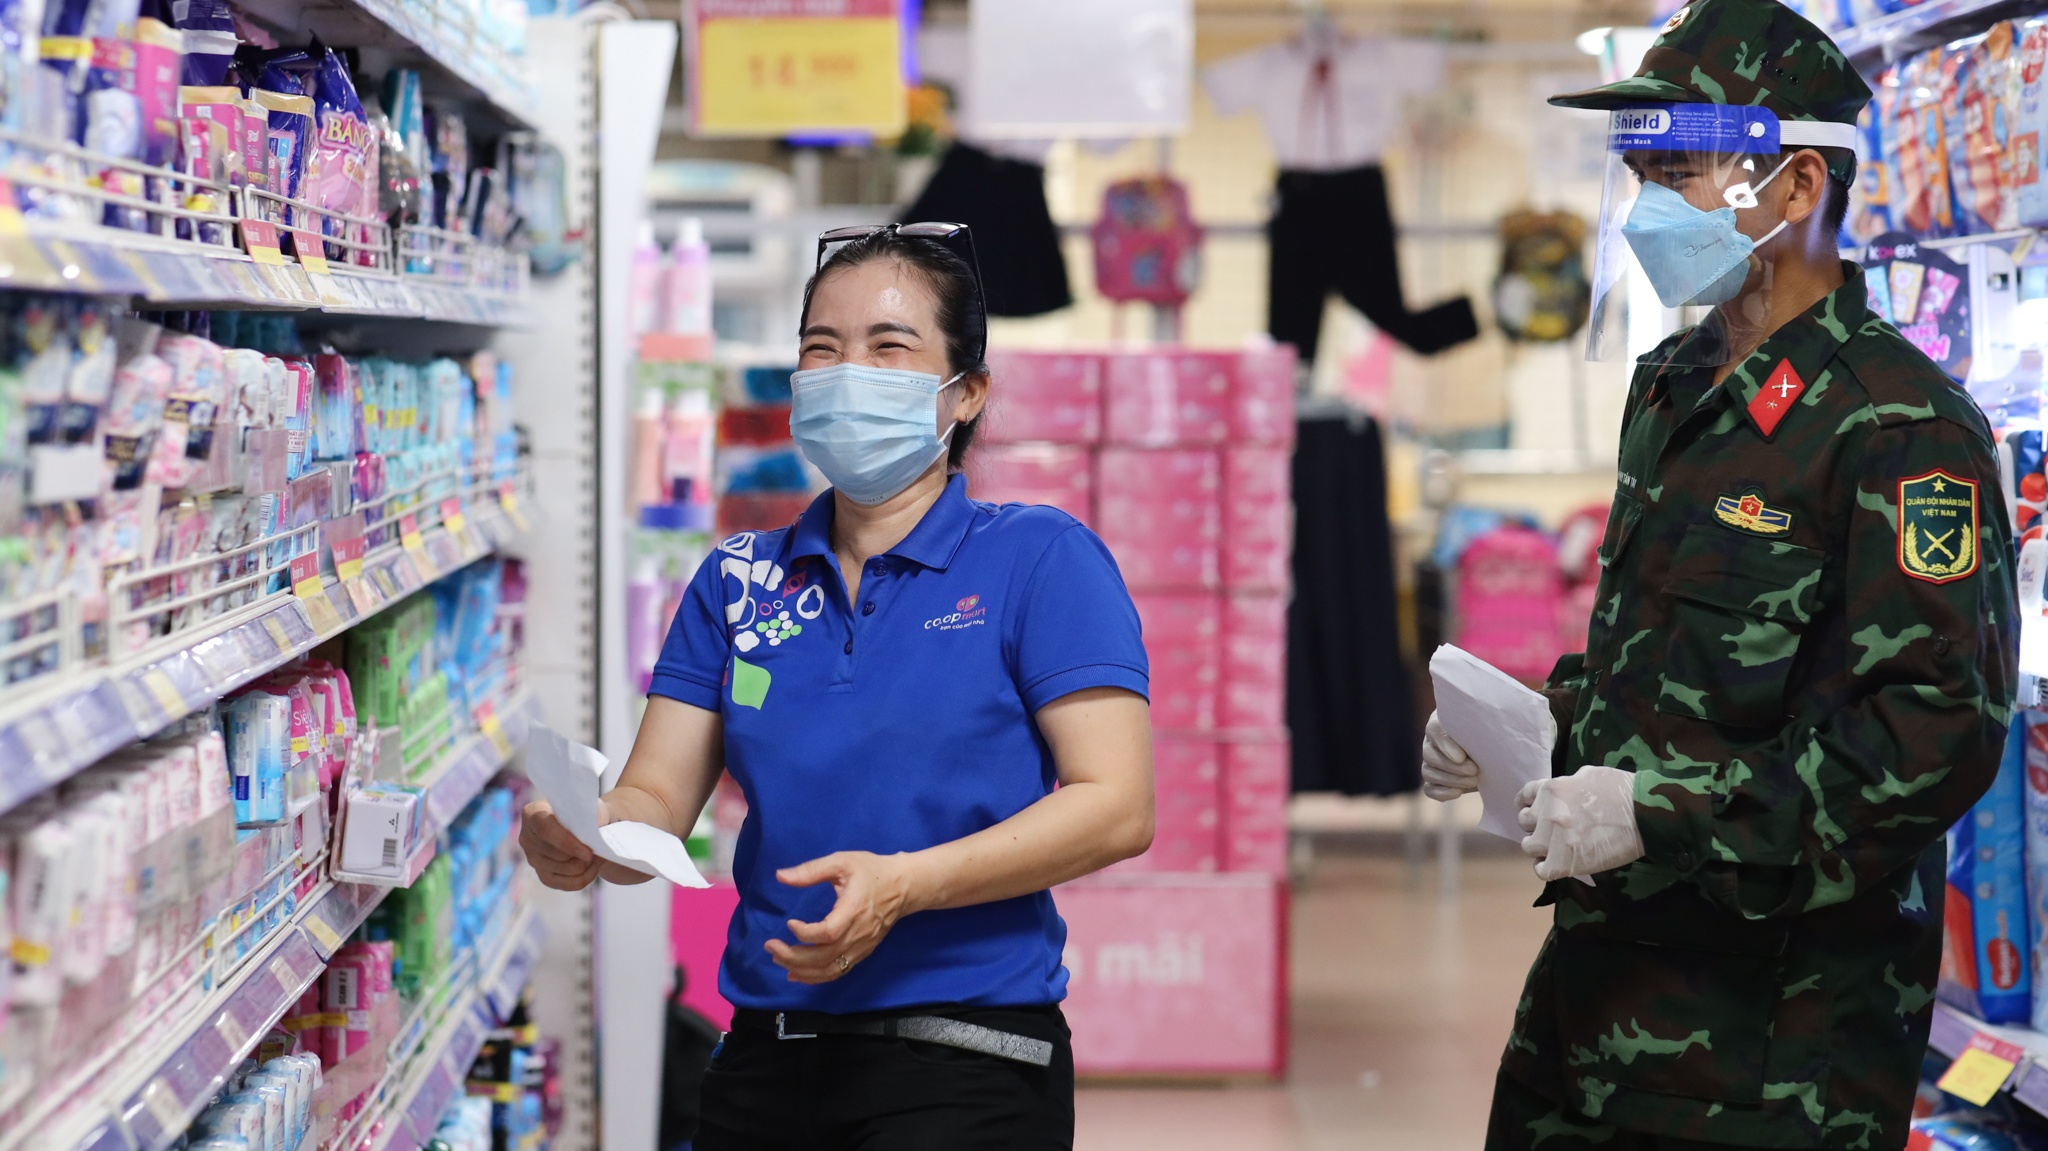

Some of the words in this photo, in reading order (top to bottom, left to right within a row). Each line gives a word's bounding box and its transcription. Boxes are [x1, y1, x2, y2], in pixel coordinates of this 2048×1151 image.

[1614, 114, 1660, 129] Shield
[1906, 496, 1926, 506] QUÂN
[1926, 496, 1938, 506] ĐỘI
[1940, 497, 1958, 506] NHÂN
[1958, 498, 1970, 508] DÂN
[1922, 508, 1940, 518] VIỆT
[1940, 509, 1957, 517] NAM
